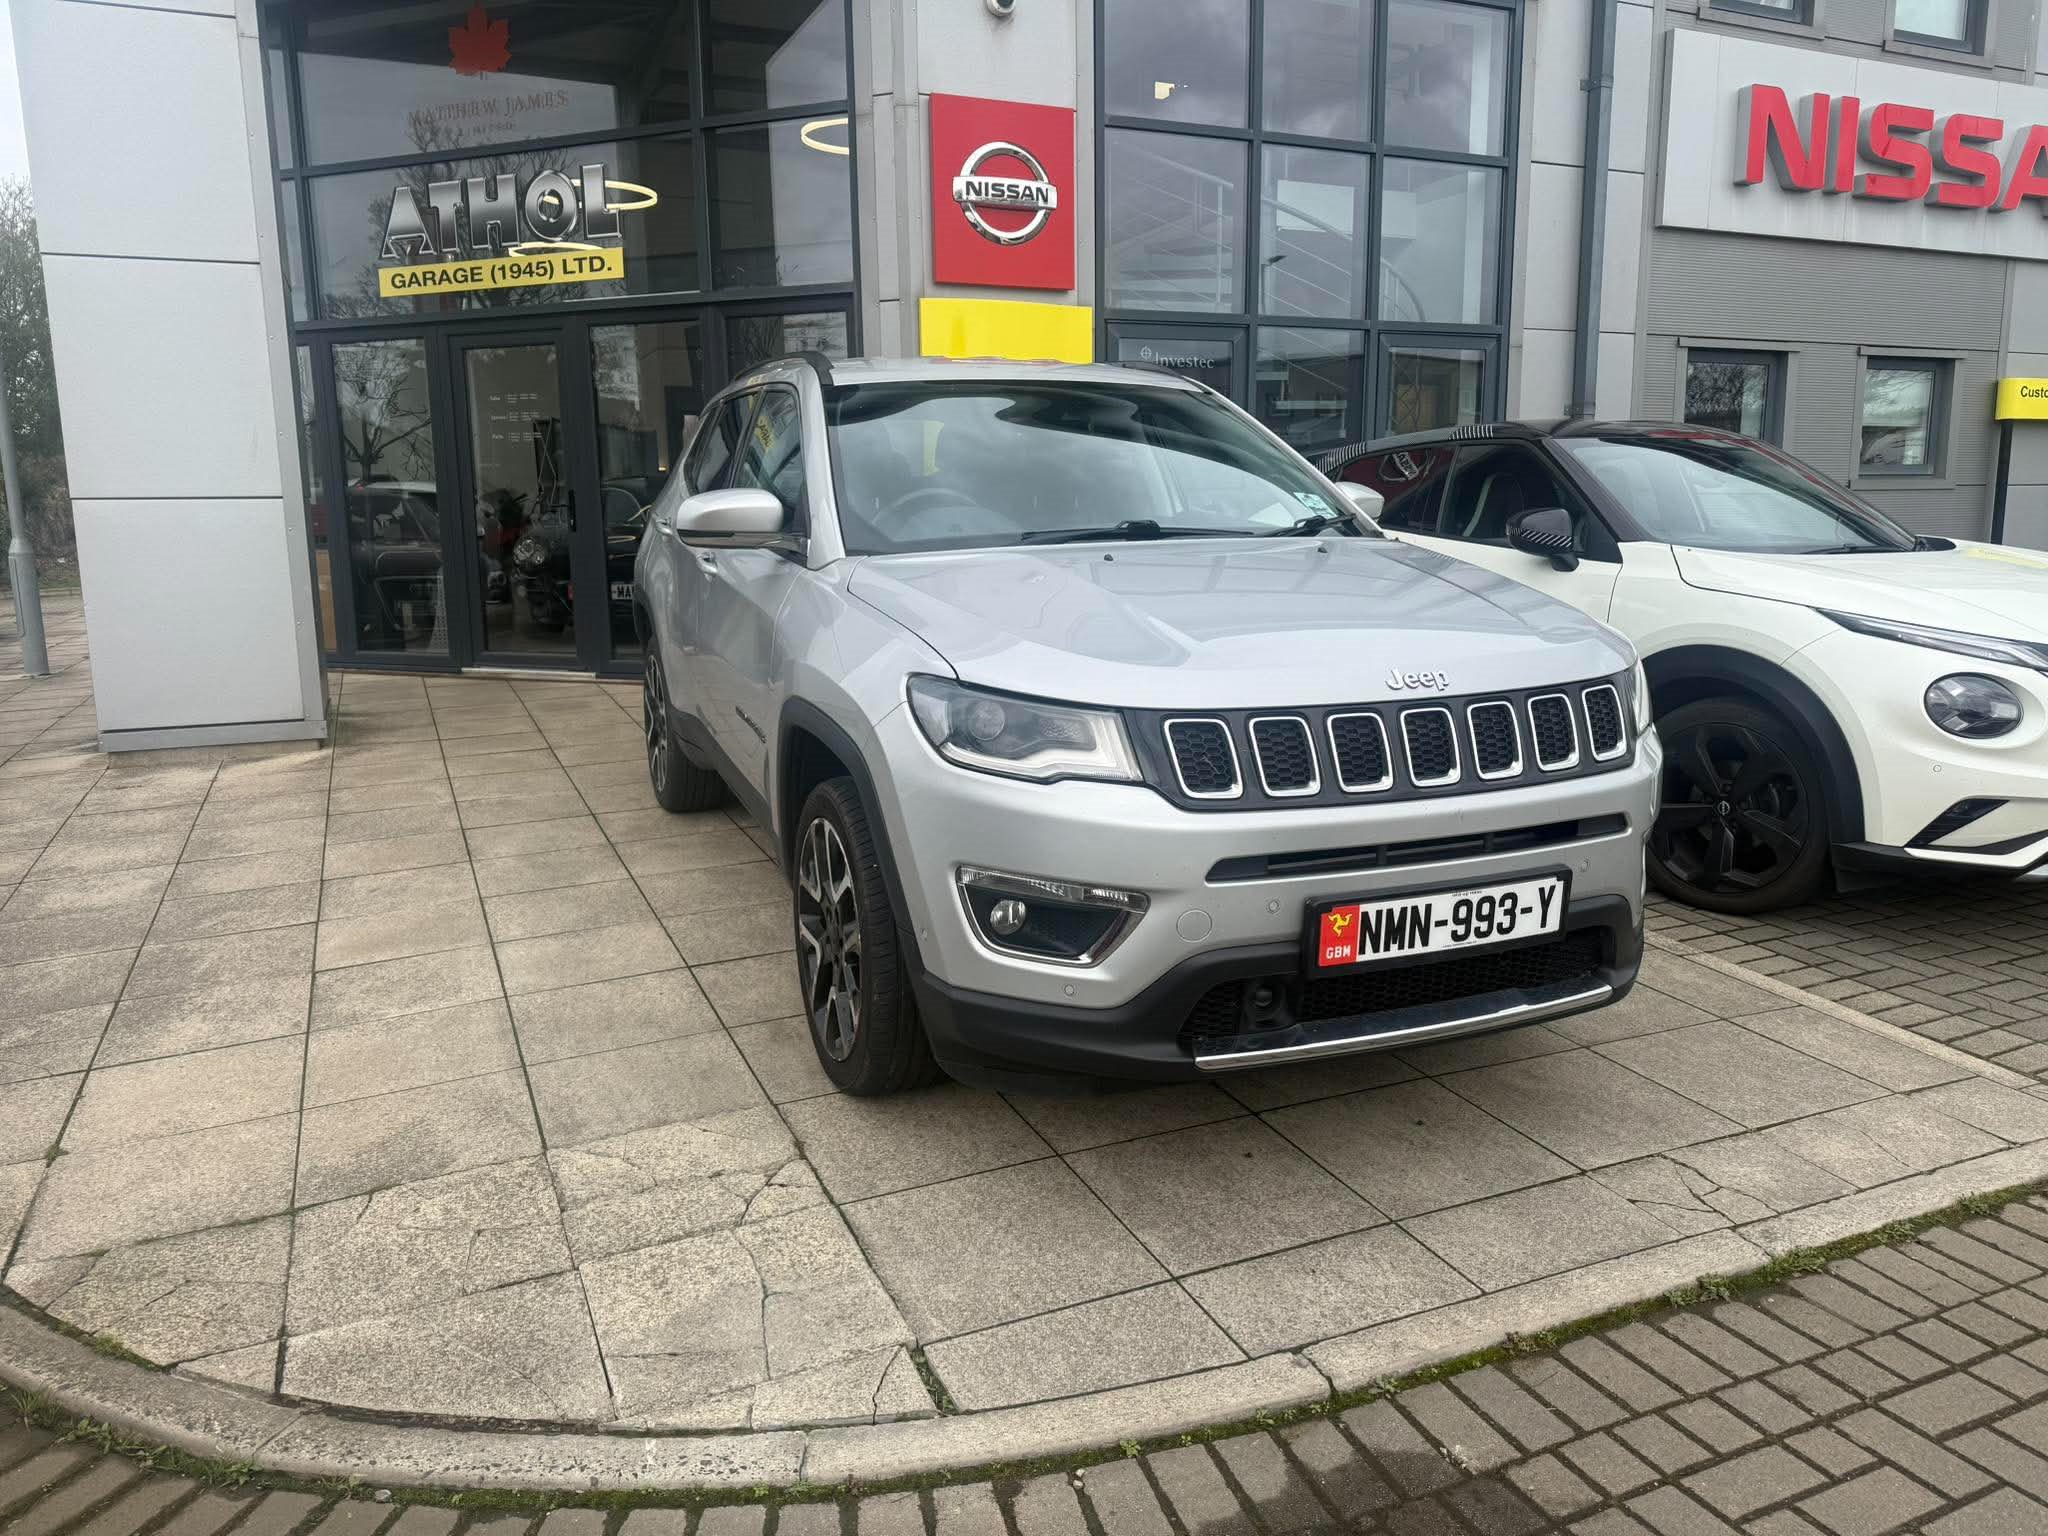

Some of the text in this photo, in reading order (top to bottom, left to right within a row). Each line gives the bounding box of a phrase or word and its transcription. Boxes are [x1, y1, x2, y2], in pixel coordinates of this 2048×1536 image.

[503, 89, 569, 118] JAMES
[965, 180, 1049, 205] NISSAN
[380, 163, 622, 260] ATHOL
[390, 254, 613, 290] GARAGE (1945) LTD.
[1155, 351, 1215, 369] Investec
[1384, 667, 1450, 692] Jeep
[1358, 884, 1557, 956] NMN-993-Y
[1325, 944, 1352, 961] GBM
